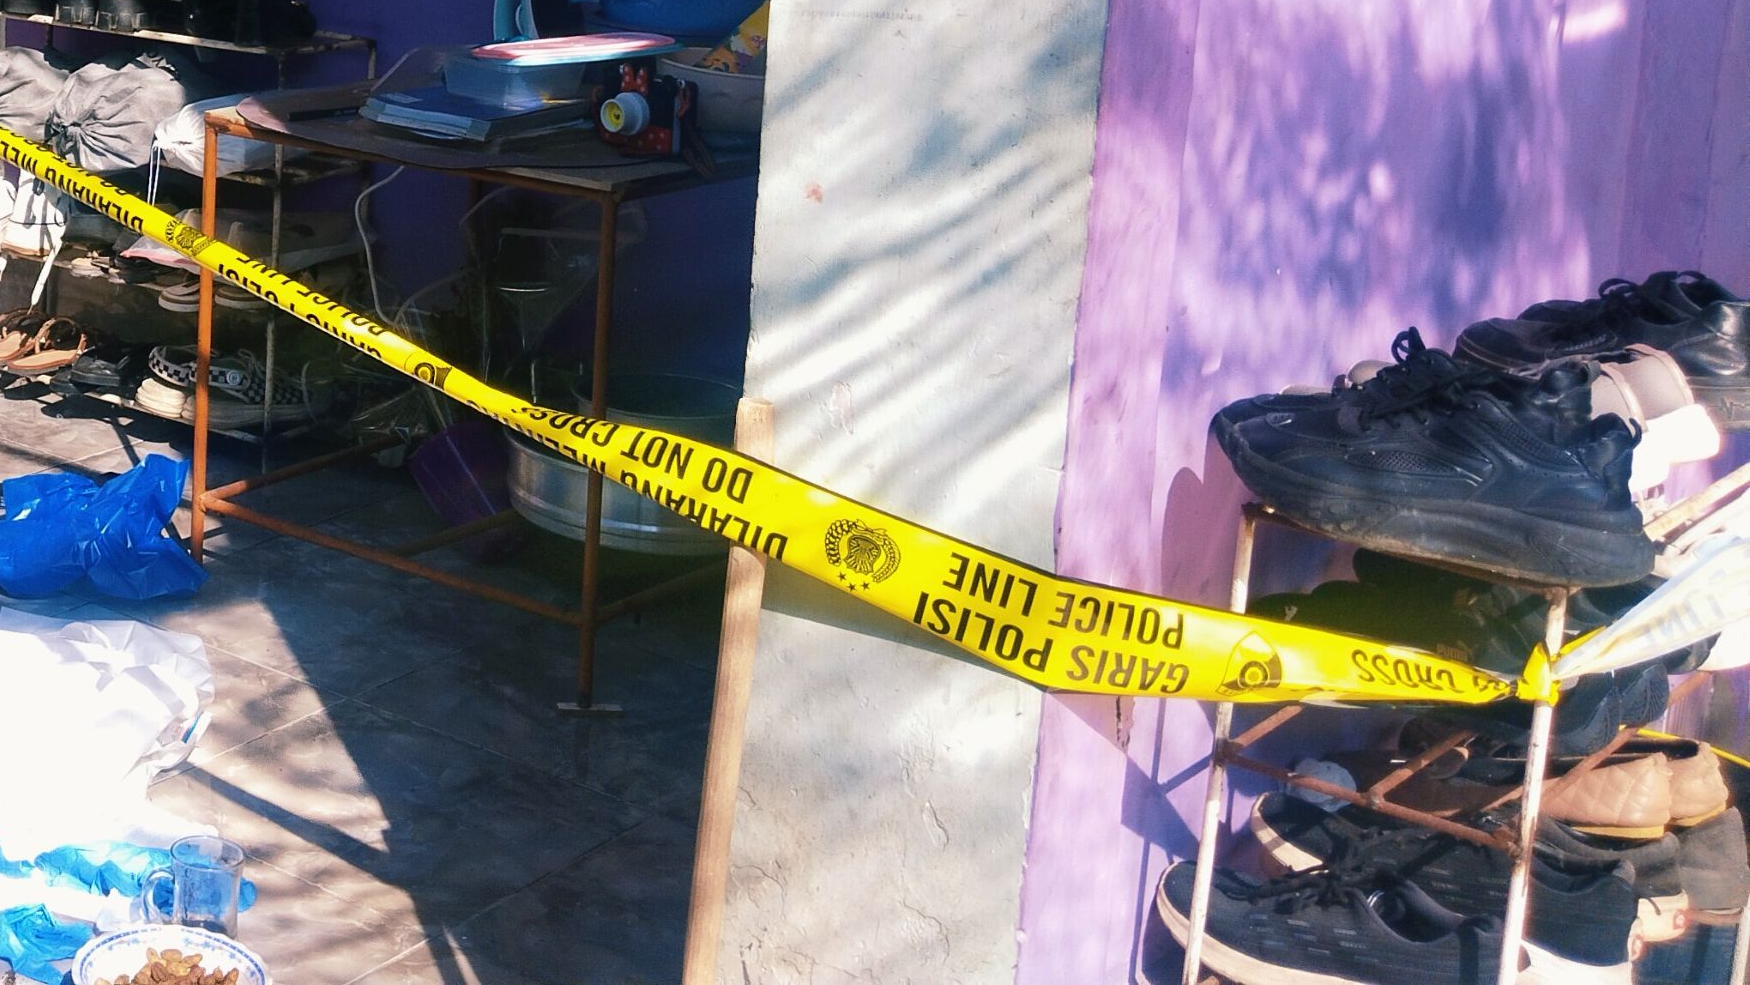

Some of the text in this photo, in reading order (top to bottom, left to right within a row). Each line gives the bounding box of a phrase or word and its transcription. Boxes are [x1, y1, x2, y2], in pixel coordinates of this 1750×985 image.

[44, 167, 145, 236] DILARANG
[619, 430, 696, 481] NOT
[701, 457, 754, 505] DO
[620, 470, 789, 562] DILARANG
[943, 551, 1184, 651] POLICE LINE
[912, 590, 1191, 695] GARIS POLISI
